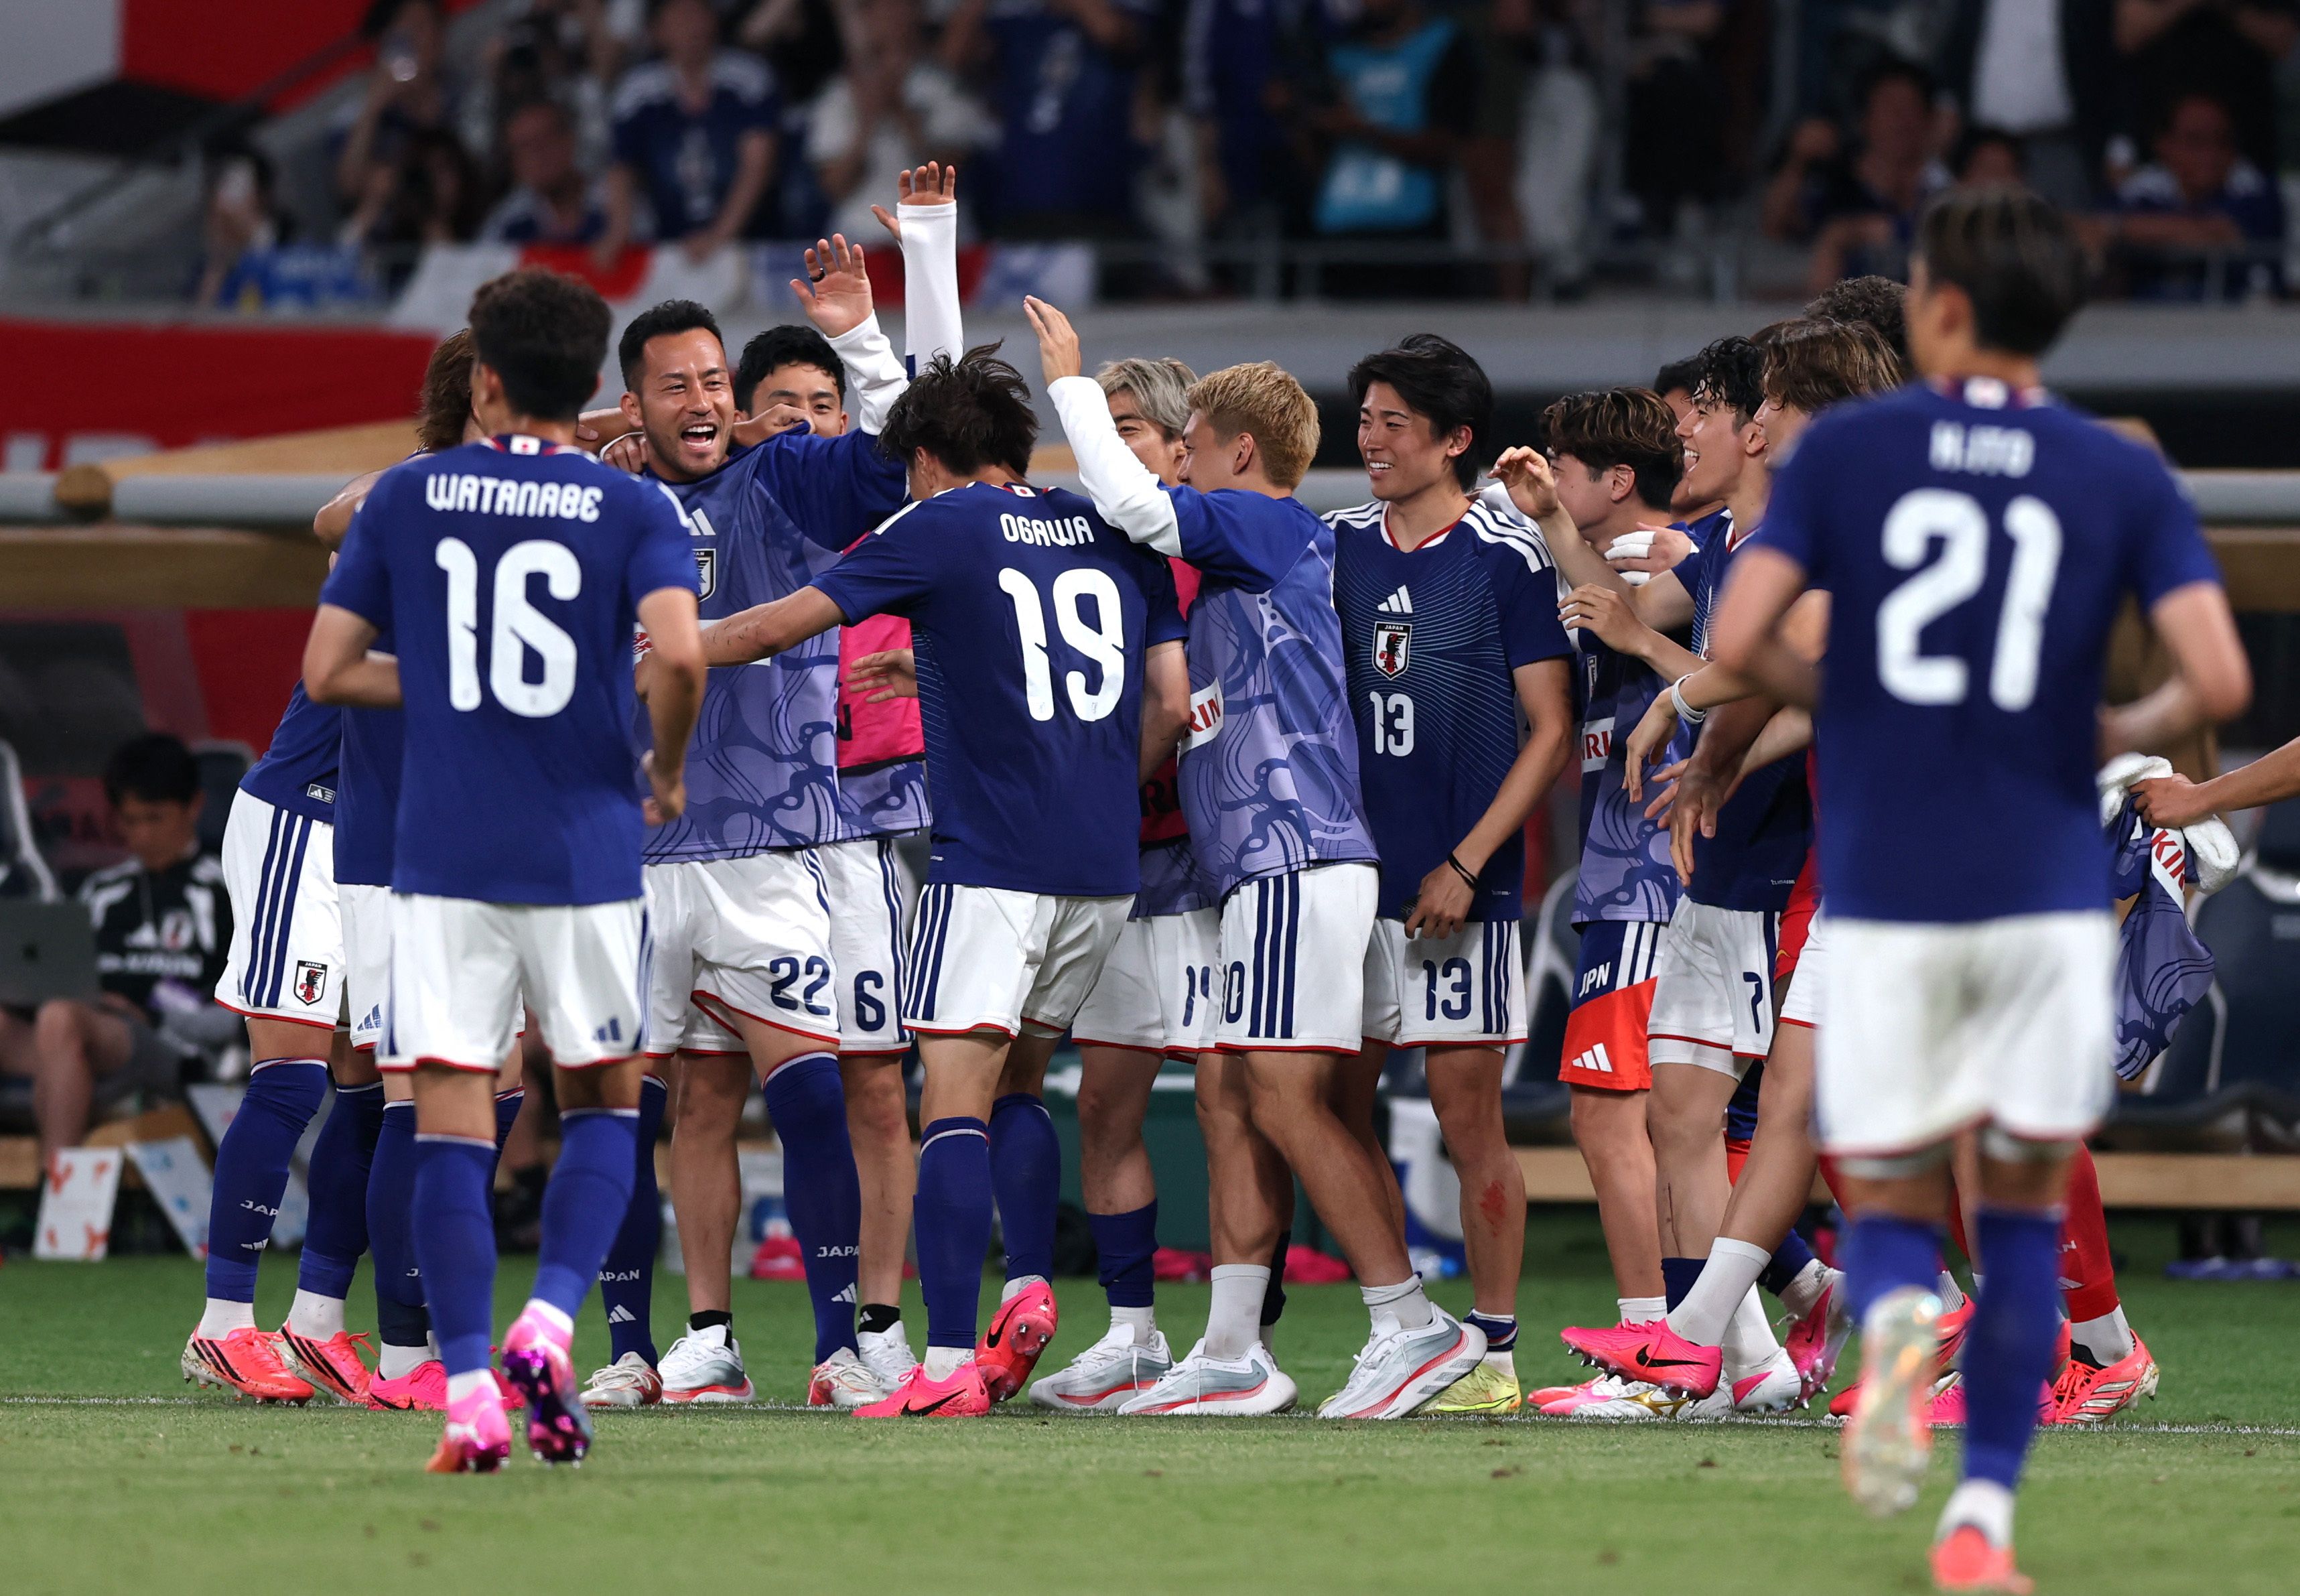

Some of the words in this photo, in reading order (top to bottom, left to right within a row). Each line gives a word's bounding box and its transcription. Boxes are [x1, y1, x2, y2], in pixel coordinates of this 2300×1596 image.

[426, 473, 603, 523] WATANABE
[1000, 513, 1094, 547] OGAWA
[435, 537, 582, 718] 16
[1878, 491, 2064, 713] 21
[999, 568, 1124, 722] 19
[1369, 691, 1414, 756] 13
[770, 955, 830, 1016] 22
[854, 970, 886, 1031] 6
[1422, 957, 1471, 1020] 13
[1578, 961, 1611, 998] JPN
[1743, 972, 1763, 1034] 7
